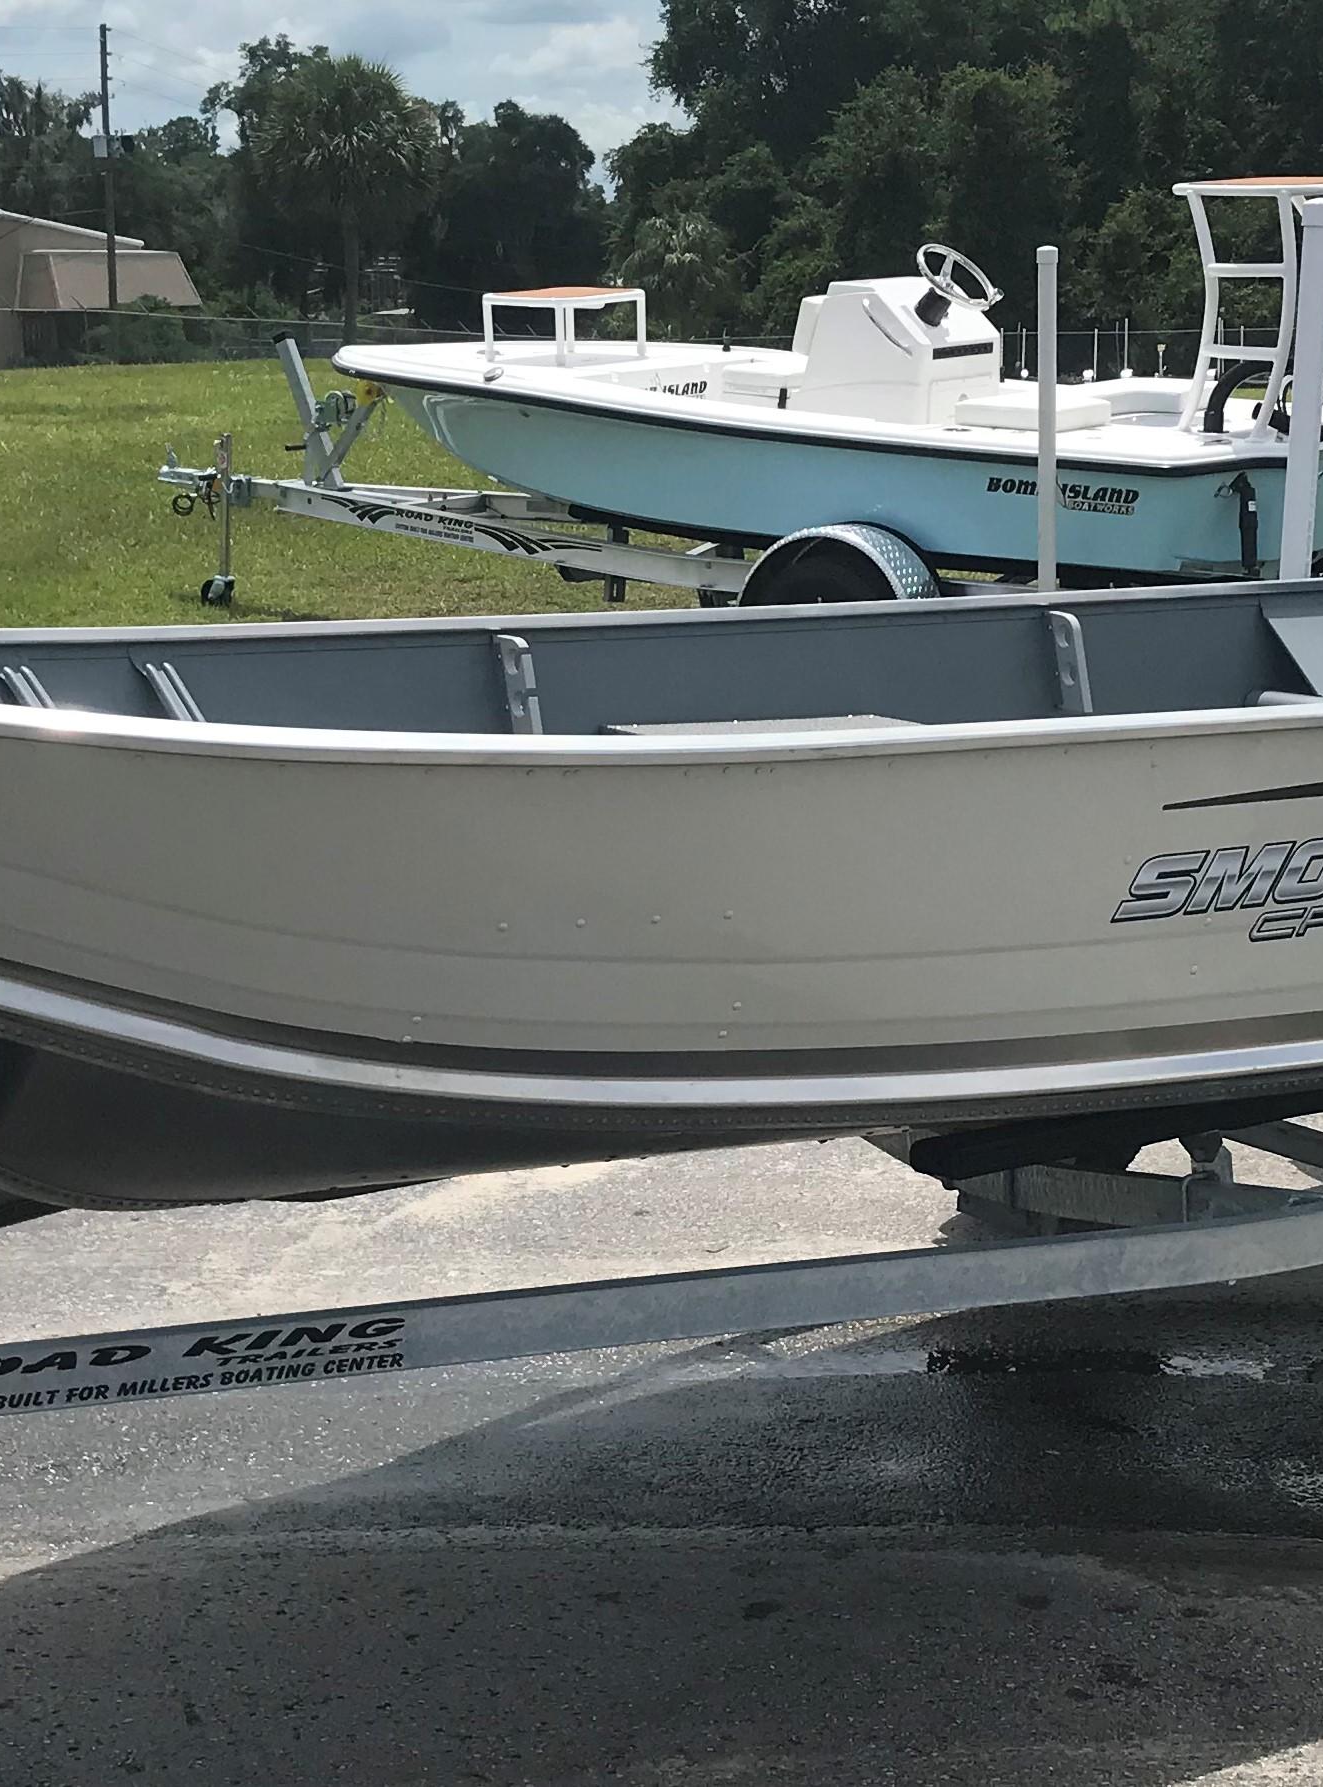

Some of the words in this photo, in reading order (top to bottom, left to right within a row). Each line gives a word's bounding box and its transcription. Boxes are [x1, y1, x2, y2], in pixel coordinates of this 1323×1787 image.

[662, 381, 708, 396] ISLAND
[986, 477, 1038, 496] BOM
[1061, 483, 1140, 505] ISLAND
[395, 508, 434, 522] ROAD
[437, 516, 474, 529] KING
[1066, 500, 1135, 516] BOATWORKS
[182, 1318, 405, 1357] KING
[216, 1338, 403, 1366] TRAILERS
[65, 1384, 109, 1403] FOR
[117, 1373, 213, 1397] MILLERS
[220, 1362, 316, 1386] BOATING
[323, 1353, 404, 1374] CENTER
